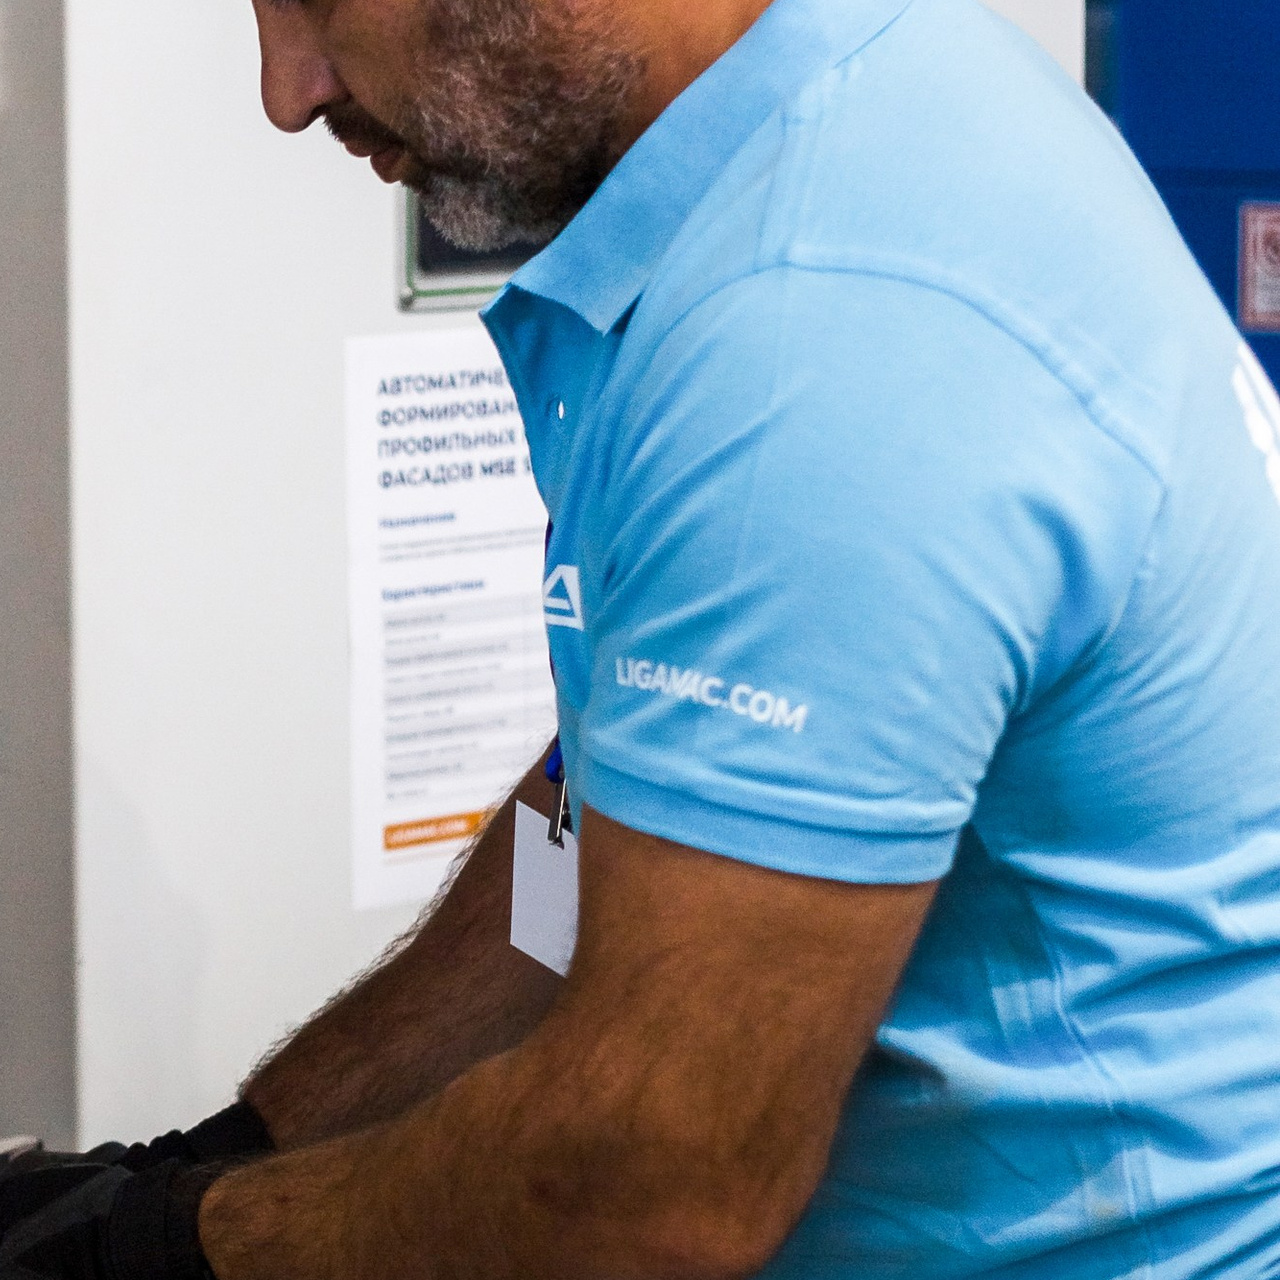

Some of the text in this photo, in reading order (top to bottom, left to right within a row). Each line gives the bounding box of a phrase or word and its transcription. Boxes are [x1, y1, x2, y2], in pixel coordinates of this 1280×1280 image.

[378, 369, 504, 395] АВТОМАТИЧЕ
[377, 399, 516, 426] ФОРМИРОВАН
[377, 429, 516, 458] ПРОФИЛЬНЫХ
[378, 460, 474, 488] ФАСАДОВ
